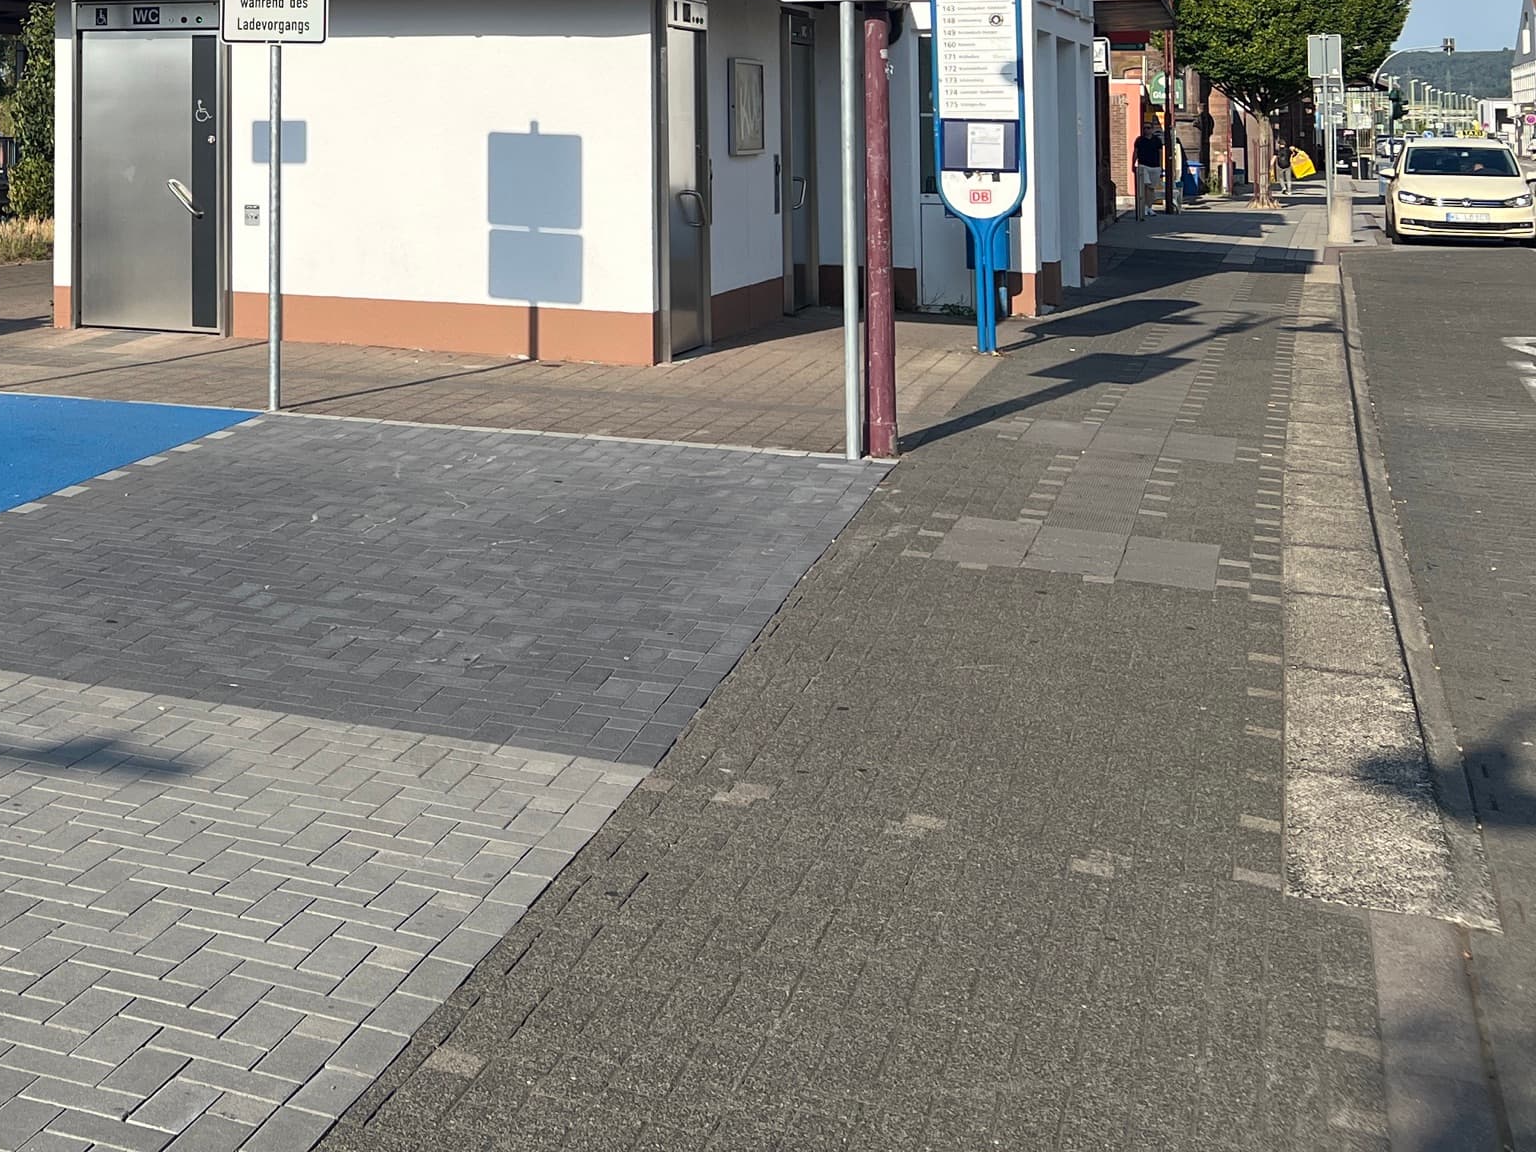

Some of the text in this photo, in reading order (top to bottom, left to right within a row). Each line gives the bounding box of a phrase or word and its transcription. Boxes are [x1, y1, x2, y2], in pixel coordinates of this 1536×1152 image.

[135, 9, 159, 22] WC
[237, 17, 310, 34] Ladevorgangs
[972, 192, 989, 202] DB
